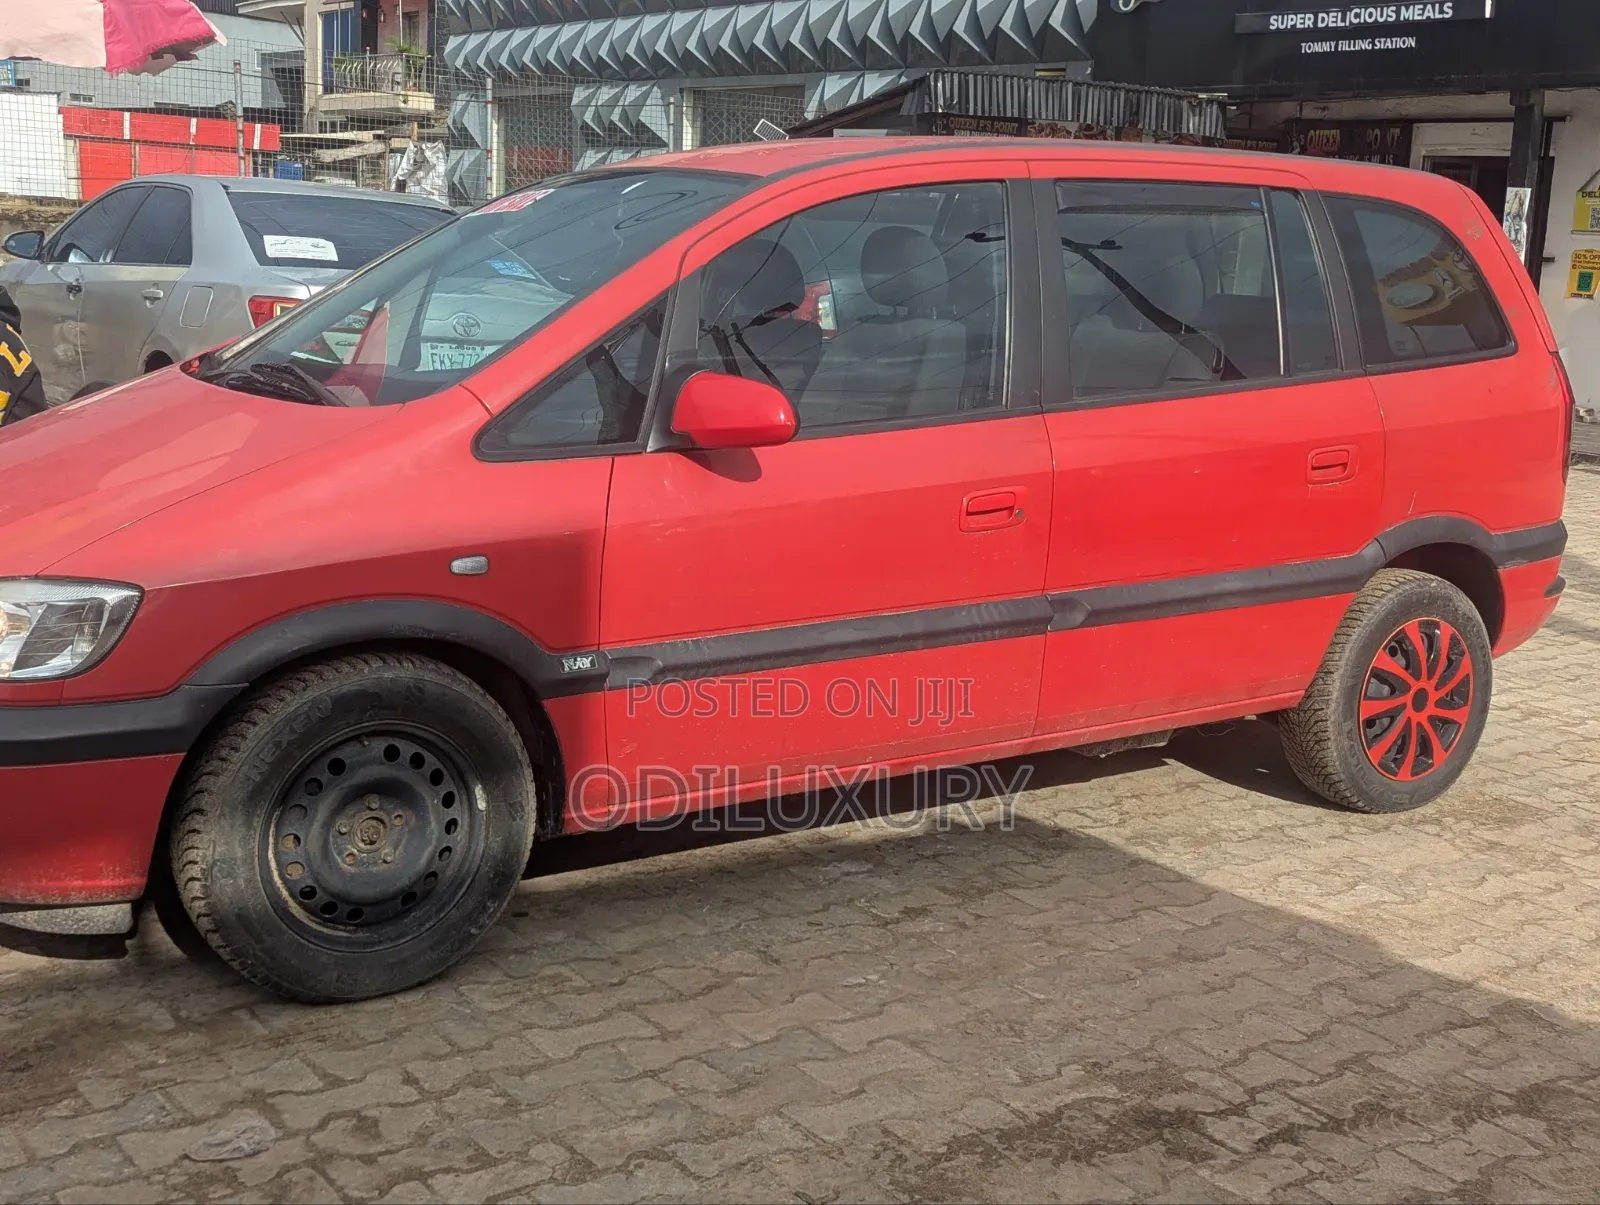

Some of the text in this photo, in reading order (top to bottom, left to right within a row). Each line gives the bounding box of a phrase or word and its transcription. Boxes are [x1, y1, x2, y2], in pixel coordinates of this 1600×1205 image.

[1269, 2, 1453, 30] SUPER DELICIOUS MEALS
[1301, 37, 1416, 53] TOMMY FILLING STATION
[949, 117, 978, 130] QUEEN
[993, 120, 1018, 134] POINT
